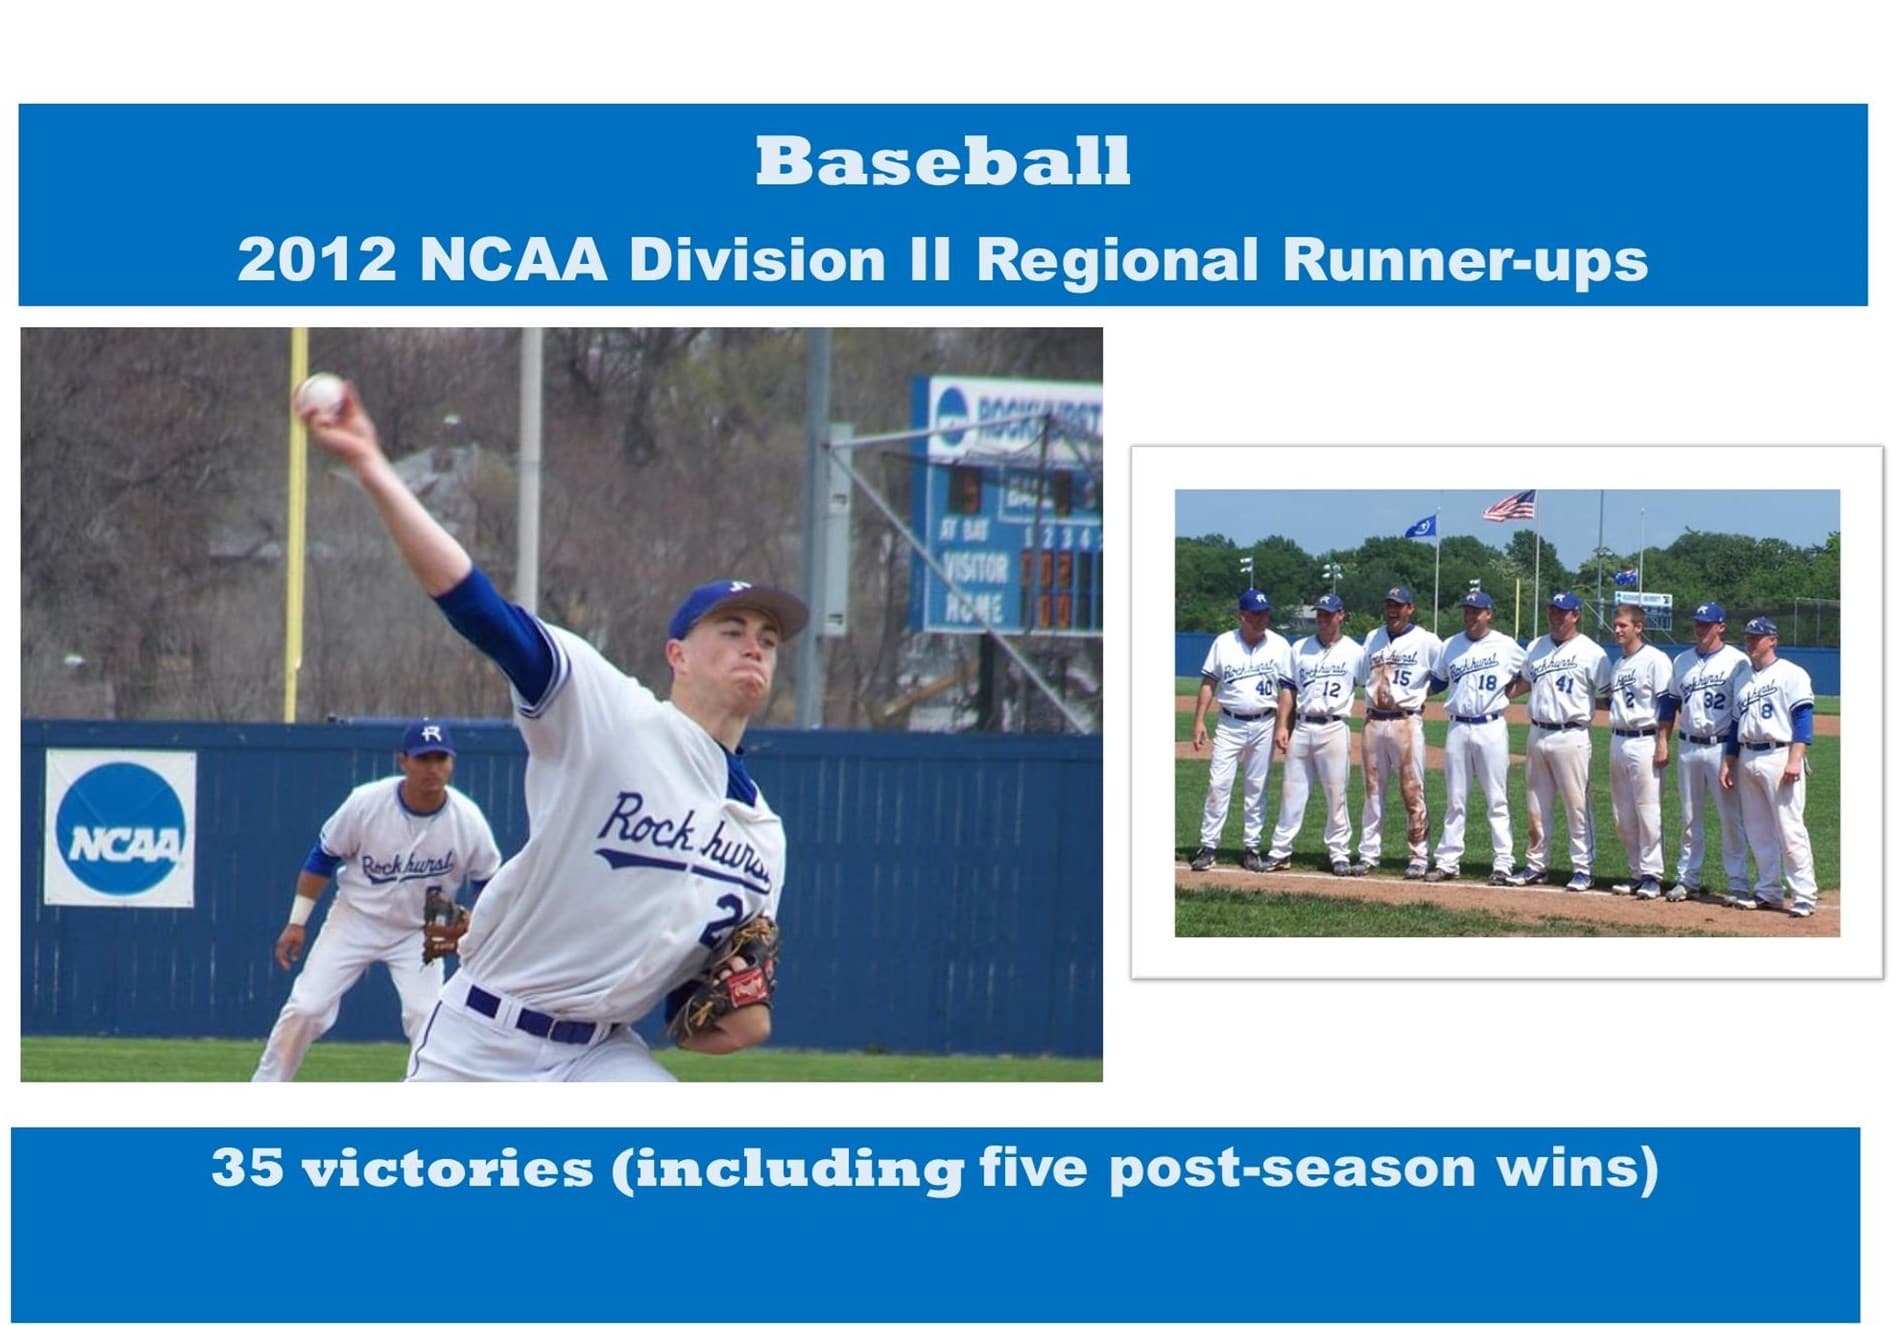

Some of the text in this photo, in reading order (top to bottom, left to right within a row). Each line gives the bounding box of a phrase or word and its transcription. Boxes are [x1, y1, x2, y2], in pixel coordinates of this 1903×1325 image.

[944, 552, 1008, 584] VISITOR
[1392, 669, 1412, 686] 15
[1478, 674, 1497, 690] 18
[1556, 676, 1574, 694] 41
[1256, 680, 1273, 696] 40
[1323, 680, 1341, 698] 12
[1625, 692, 1635, 708] 2
[1761, 703, 1773, 720] 8
[421, 726, 442, 742] R
[69, 826, 181, 862] NCAA
